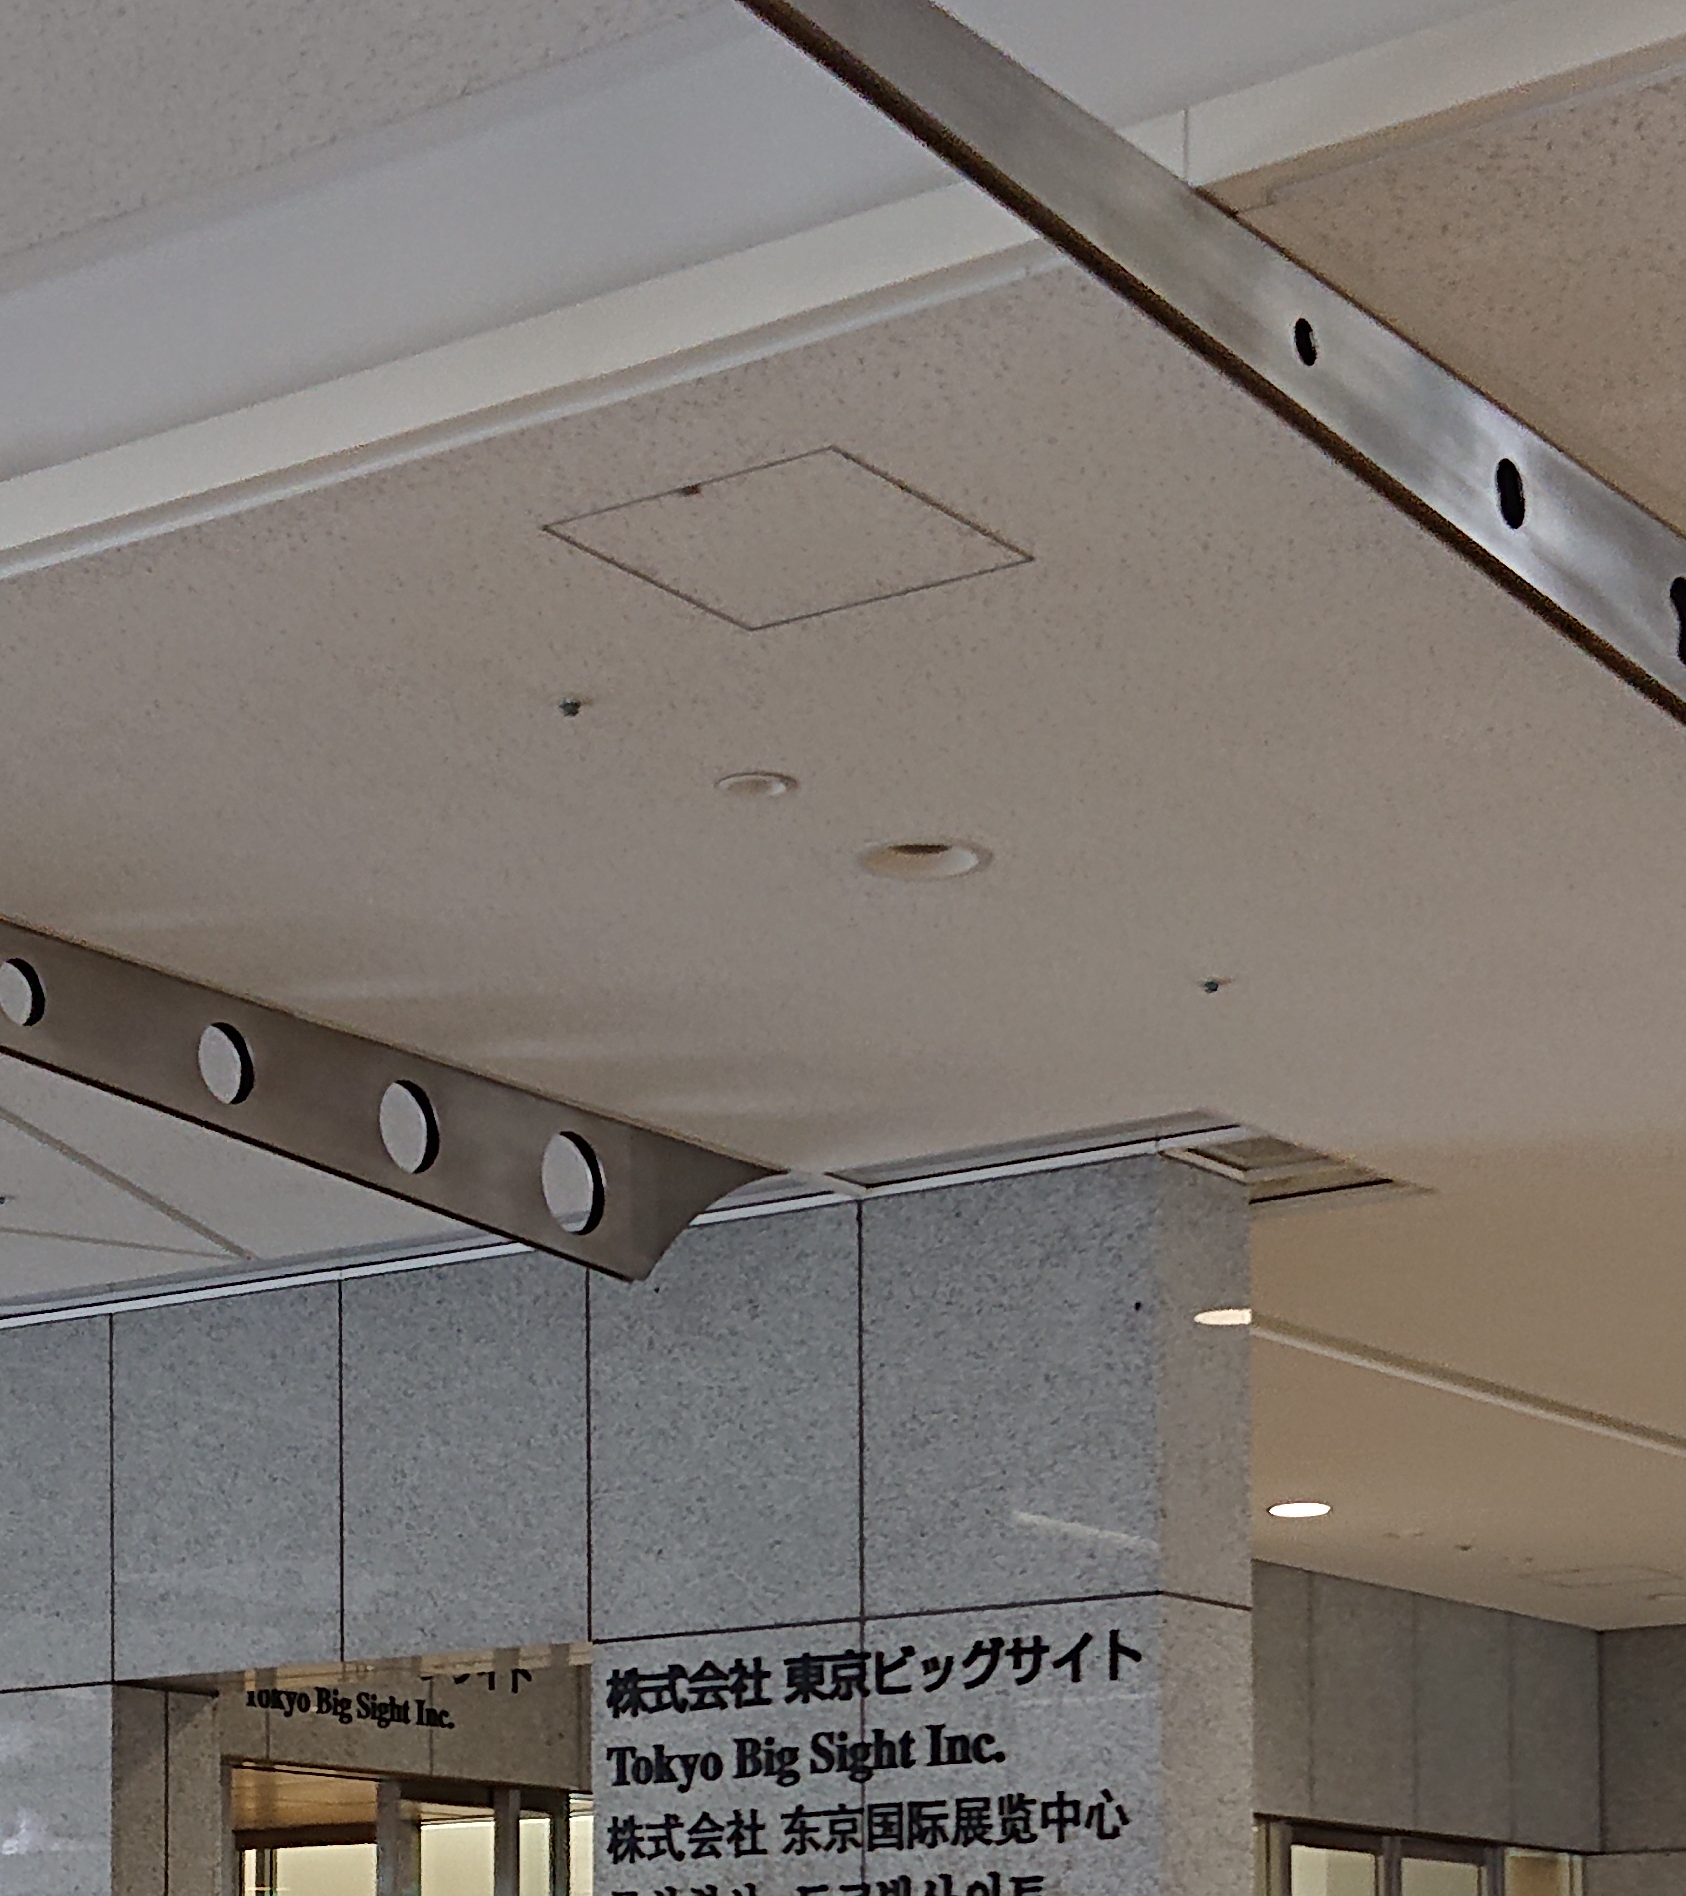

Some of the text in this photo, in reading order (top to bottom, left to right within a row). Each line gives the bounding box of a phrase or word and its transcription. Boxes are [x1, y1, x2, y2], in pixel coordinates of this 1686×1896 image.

[246, 1686, 456, 1729] Tokyo Big Sight Inc.
[606, 1629, 1142, 1718] 株式会社 東京ビッグサイト
[606, 1723, 1006, 1793] Tokyo Big Sight Inc.
[606, 1788, 1131, 1864] 株式会社 东京国际展览中心
